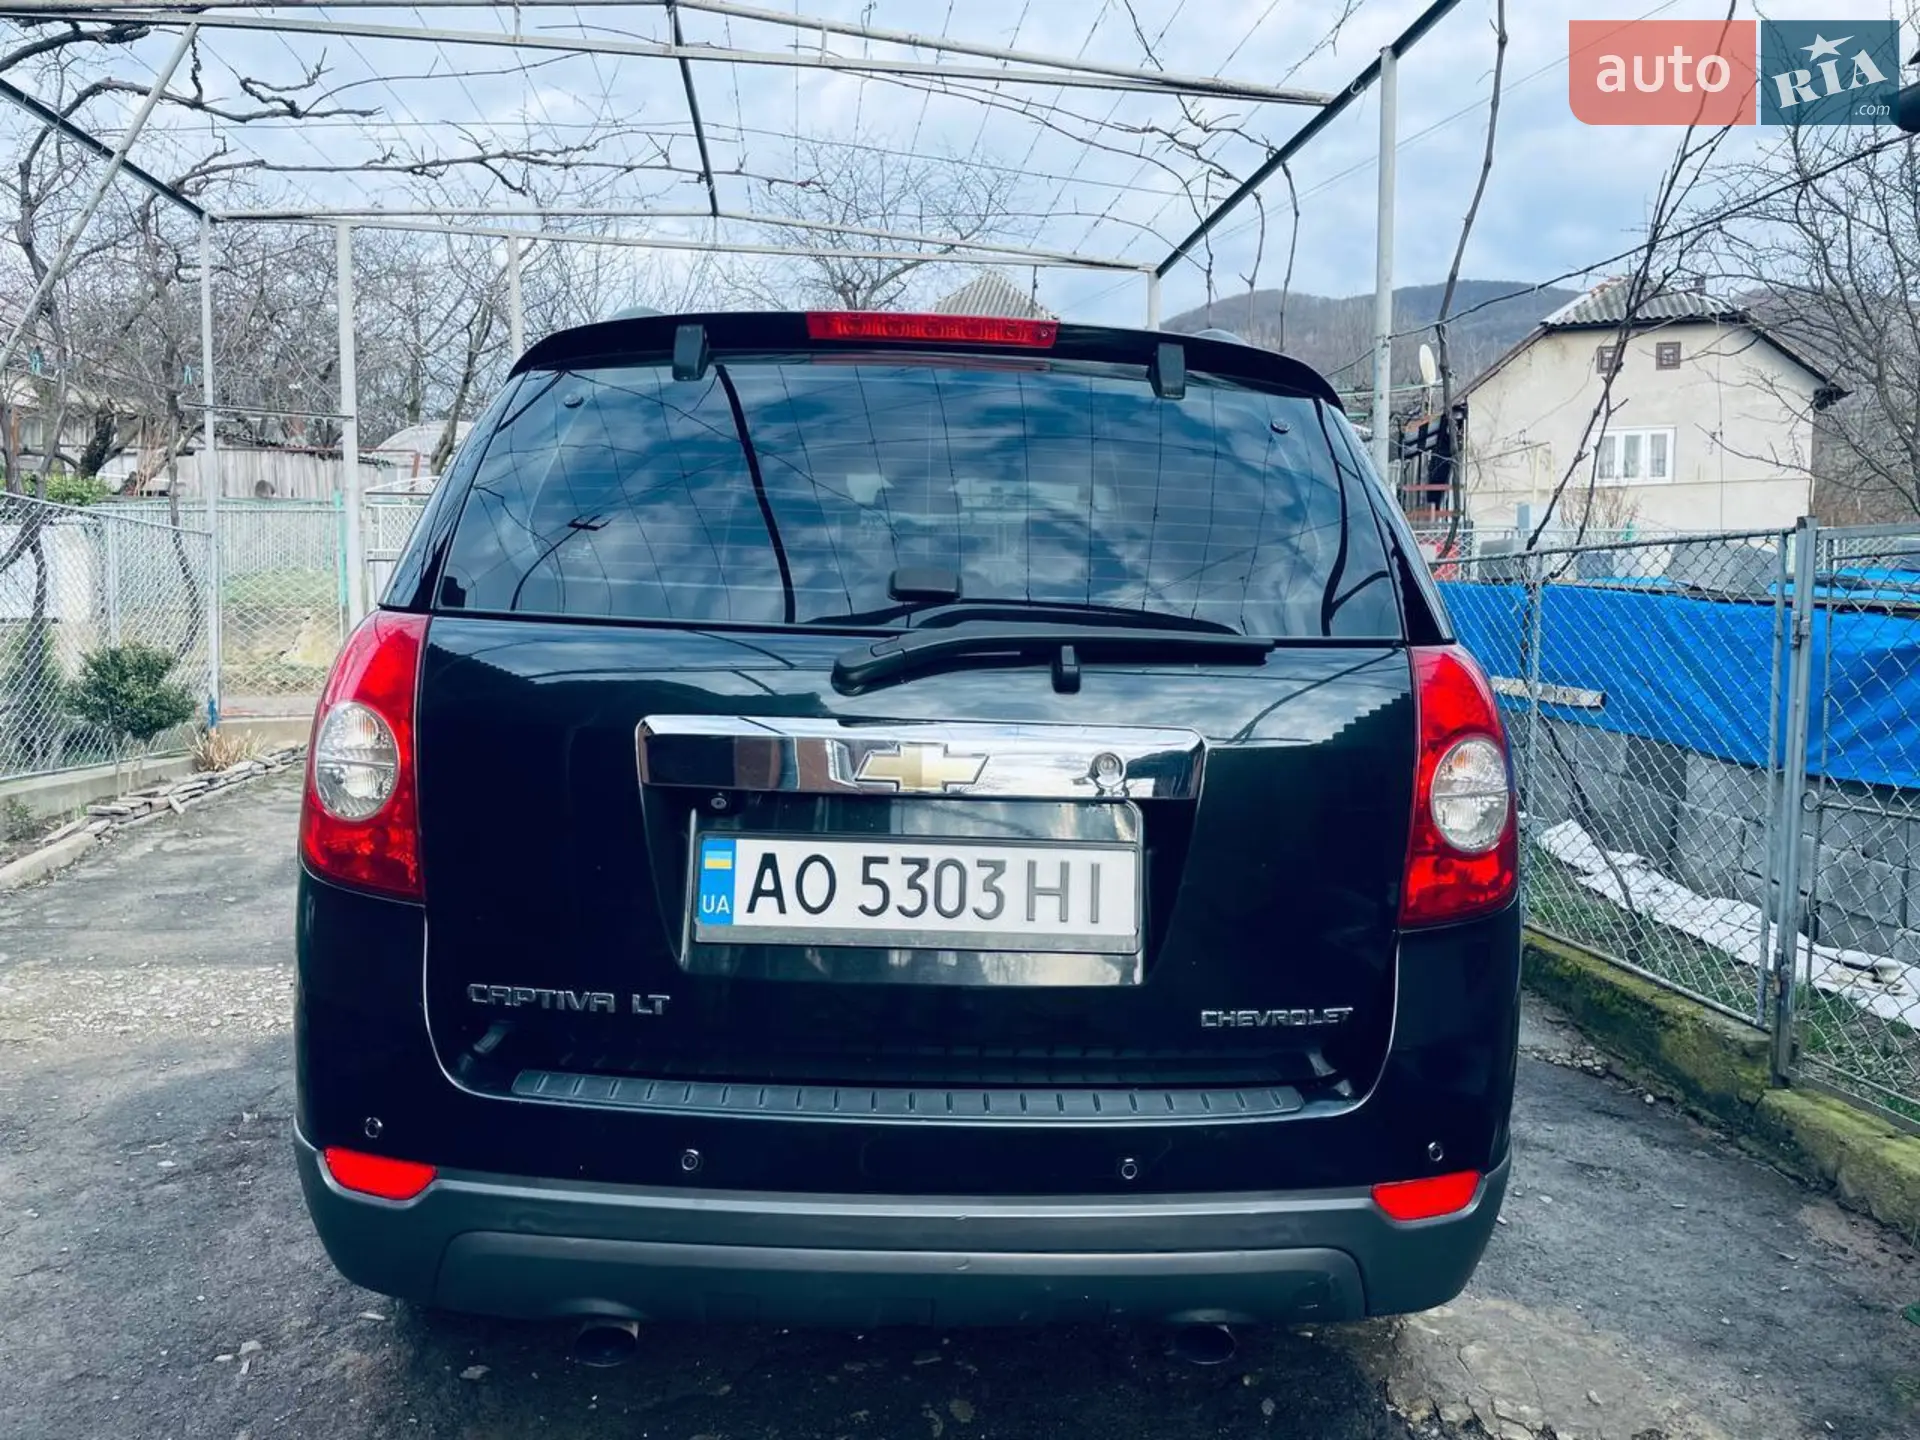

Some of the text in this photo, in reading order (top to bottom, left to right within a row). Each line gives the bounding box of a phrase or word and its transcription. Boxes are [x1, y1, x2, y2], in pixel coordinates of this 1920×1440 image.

[746, 852, 1100, 924] AO 5303 HI
[702, 895, 730, 915] UA
[467, 983, 670, 1015] CAPTIVA LT
[1201, 1007, 1354, 1028] CHEVROLET
